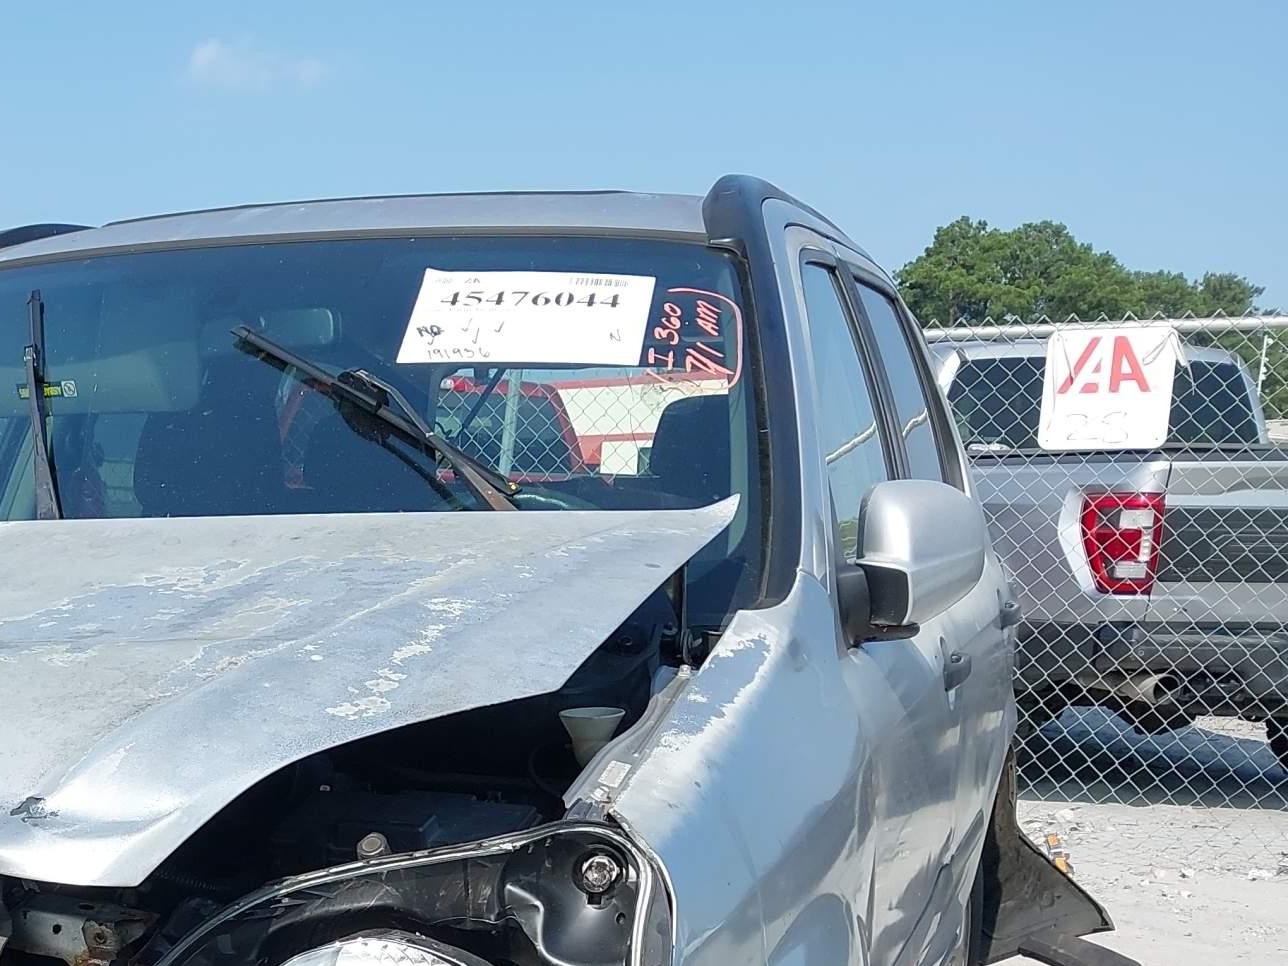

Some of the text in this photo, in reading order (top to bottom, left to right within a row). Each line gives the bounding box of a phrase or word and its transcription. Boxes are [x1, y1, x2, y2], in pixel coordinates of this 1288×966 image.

[440, 291, 620, 309] 45476044
[695, 299, 723, 336] AM
[654, 302, 682, 345] 360
